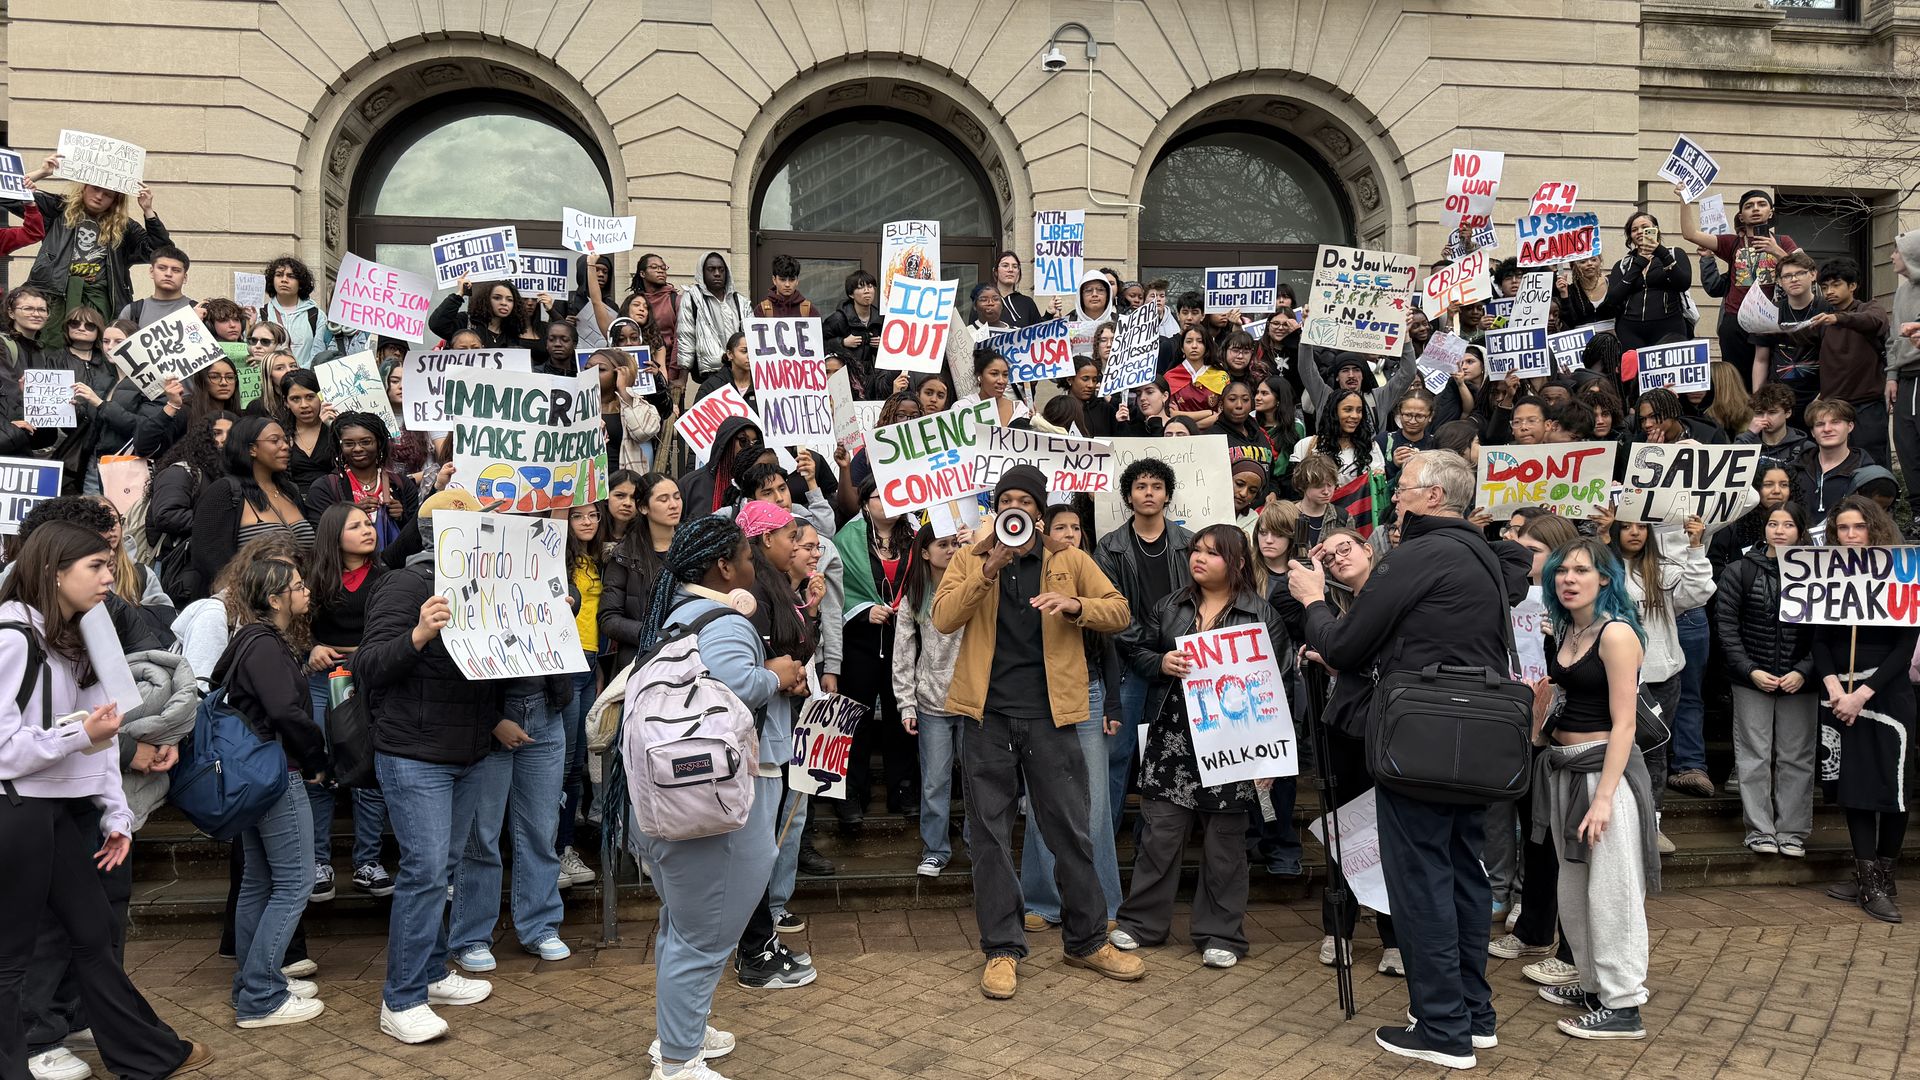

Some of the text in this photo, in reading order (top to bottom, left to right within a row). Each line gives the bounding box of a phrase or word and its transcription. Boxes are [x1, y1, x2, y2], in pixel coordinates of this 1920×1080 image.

[64, 132, 140, 161] BORDERS ARE
[73, 146, 138, 175] BULLSHIT
[1453, 154, 1481, 178] NO
[1681, 144, 1713, 181] ICE OUT!
[1462, 179, 1497, 197] war
[1561, 184, 1576, 204] 4
[1689, 177, 1705, 198] ICE!
[1445, 195, 1469, 214] on
[575, 213, 622, 230] CHINGA
[886, 221, 937, 238] BURN
[1518, 212, 1599, 238] LP Stands
[566, 226, 627, 245] LA MIGRA
[890, 236, 928, 246] ICE
[442, 236, 494, 262] ICE OUT!
[1322, 249, 1347, 268] Do
[1351, 250, 1380, 272] You
[480, 254, 507, 272] ICE!
[533, 256, 561, 275] OUT!
[1036, 257, 1078, 293] 4 ALL
[1427, 250, 1484, 297] CRUSH
[547, 277, 566, 292] ICE!
[1216, 271, 1266, 289] ICE OUT!
[1523, 273, 1543, 290] THE
[339, 278, 430, 313] AMERICAN
[888, 280, 955, 321] ICE
[1208, 289, 1273, 307] ¡Fuera ICE!
[1433, 278, 1478, 318] ICE
[1494, 301, 1511, 316] ICE
[751, 320, 815, 357] ICE
[883, 319, 948, 360] OUT
[1335, 317, 1400, 336] then VOTE
[114, 319, 184, 378] I only
[146, 339, 186, 365] Like
[995, 338, 1070, 366] ake USA
[1489, 335, 1503, 353] ICE
[1504, 331, 1534, 351] OUT!
[1558, 333, 1587, 351] OUT!
[156, 358, 177, 374] my
[1104, 353, 1155, 383] to teach
[1519, 352, 1545, 370] ICE!
[1645, 346, 1696, 370] ICE OUT!
[25, 371, 62, 384] DON'T
[754, 358, 828, 392] MURDERS
[1008, 362, 1062, 383] reat
[1679, 366, 1706, 384] ICE!
[36, 385, 67, 396] TAKE
[427, 376, 445, 397] WI
[24, 396, 47, 405] THE
[414, 400, 429, 423] BE
[444, 379, 600, 428] IMMIGRANTS
[680, 388, 749, 450] HANDS
[764, 394, 833, 437] MOTHERS
[456, 424, 606, 463] MAKE AMERICA
[874, 401, 996, 465] SILENCE
[990, 425, 1092, 453] PROTECT
[928, 449, 961, 471] IS
[1064, 453, 1111, 471] NOT
[1486, 447, 1606, 483] DONT
[1631, 445, 1756, 490] SAVE
[476, 453, 610, 514] GREAT
[883, 462, 980, 508] COMPLI
[1052, 470, 1109, 492] POWER
[1195, 468, 1206, 487] A
[1480, 480, 1548, 507] TAKE
[1550, 478, 1606, 504] OUR
[1202, 496, 1211, 516] of
[438, 525, 539, 581] Gritando Lo
[541, 524, 562, 558] ICE
[1783, 547, 1893, 582] STAND
[442, 586, 476, 632] Que
[480, 583, 510, 630] Mis
[1780, 580, 1889, 624] SPEAK
[559, 628, 570, 642] ICE
[451, 637, 503, 679] Callan
[517, 631, 565, 674] Miedo
[1183, 628, 1268, 669] ANTI
[804, 694, 841, 729] THIS
[1186, 670, 1279, 733] ICE
[790, 727, 853, 777] IS A VOTE
[1201, 739, 1290, 772] WALKOUT
